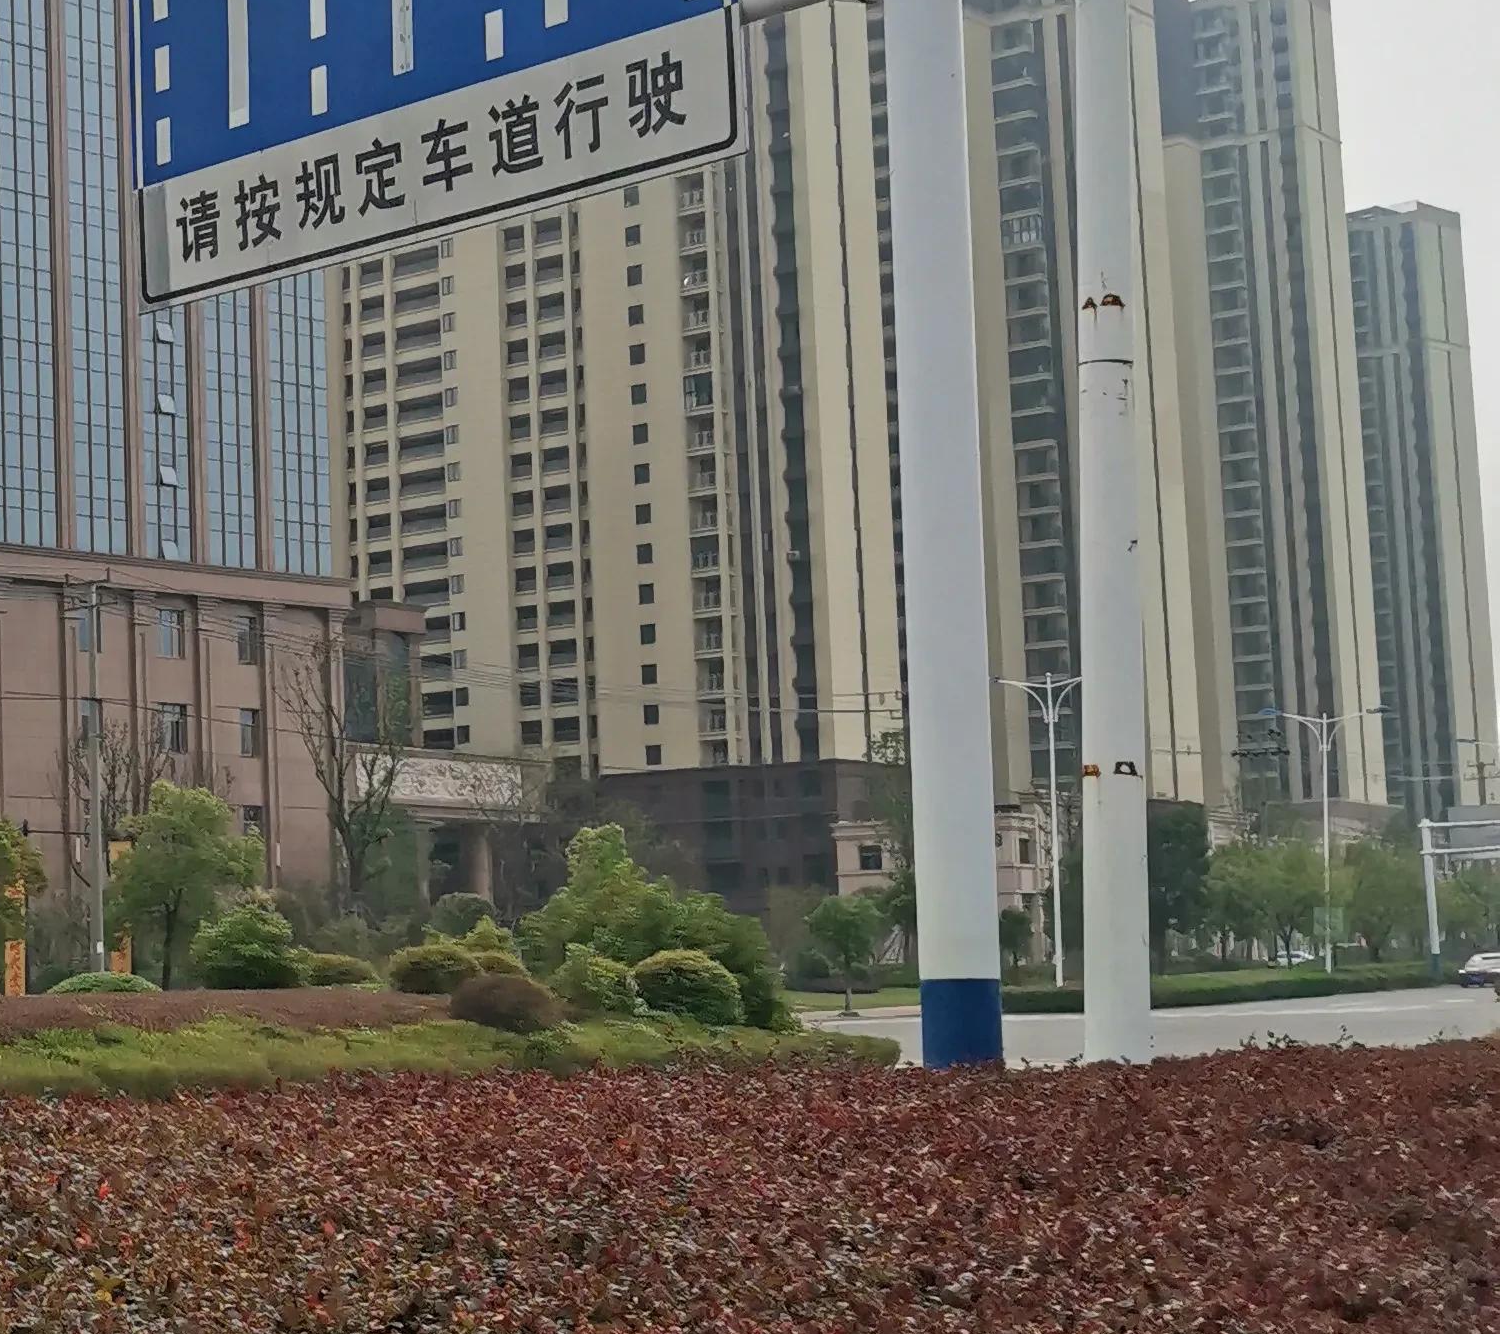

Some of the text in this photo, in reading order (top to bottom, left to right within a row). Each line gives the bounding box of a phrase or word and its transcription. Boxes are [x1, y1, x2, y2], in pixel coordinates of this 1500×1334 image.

[176, 51, 687, 263] 请按规定车道行驶
